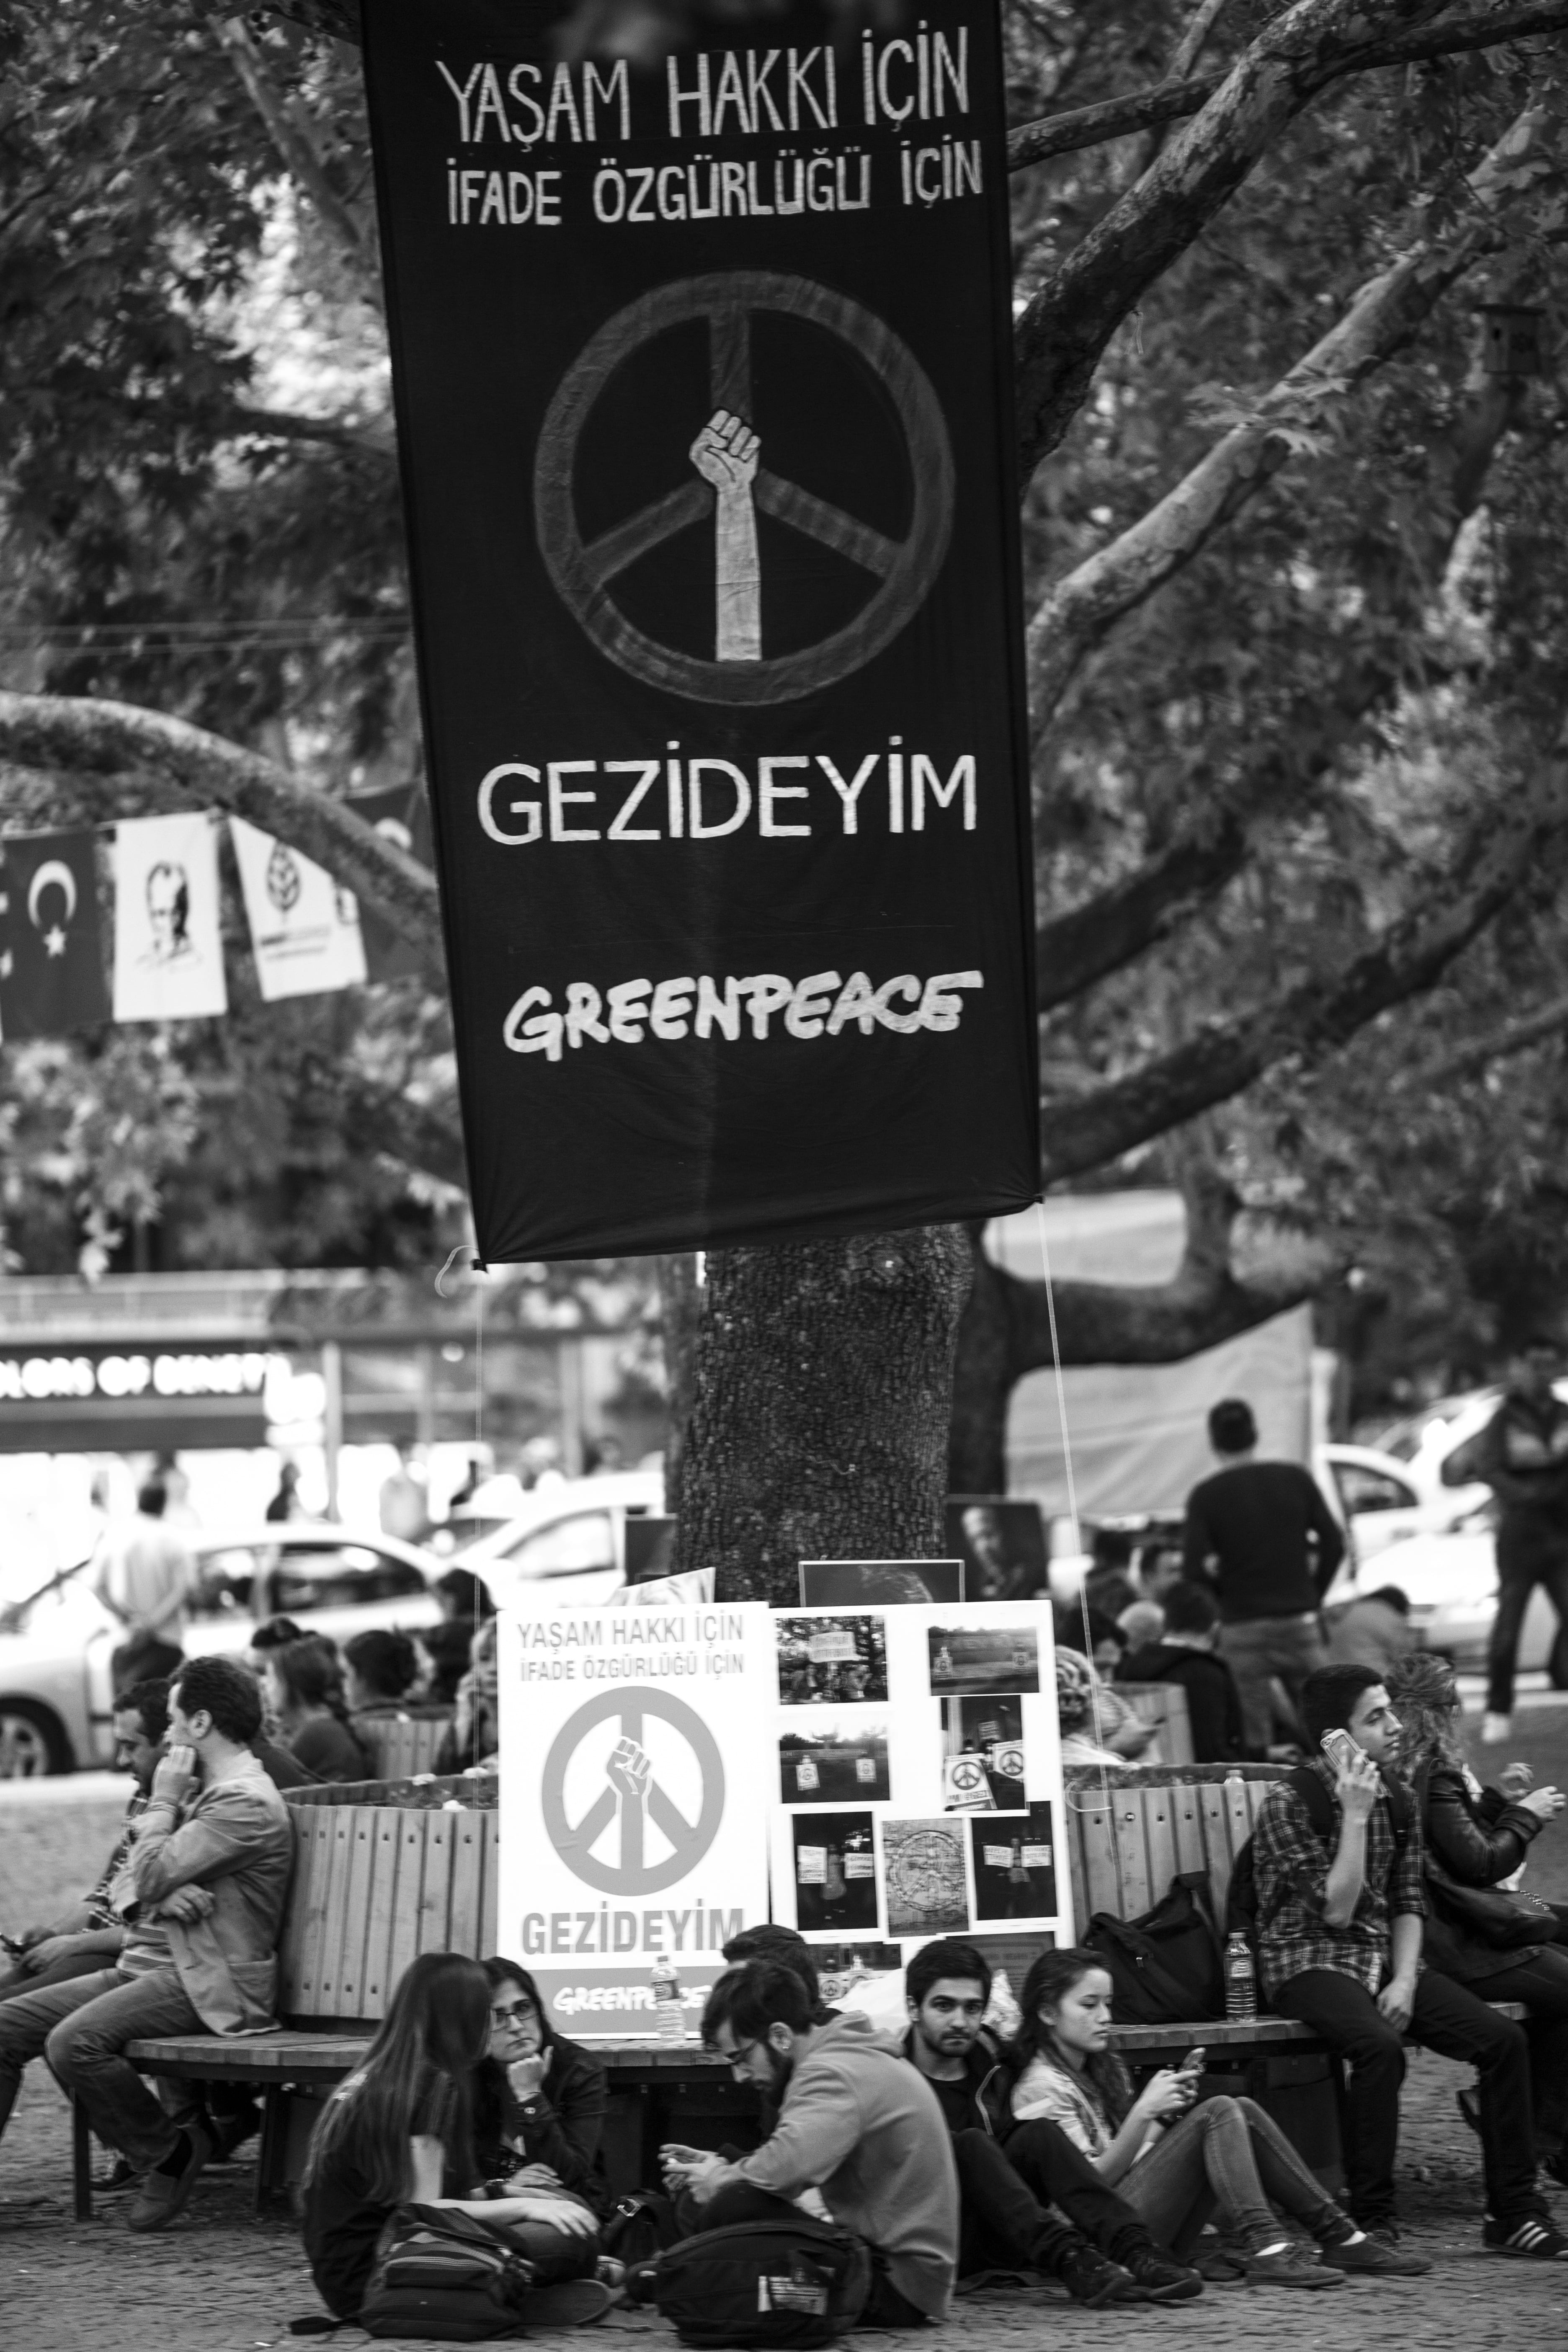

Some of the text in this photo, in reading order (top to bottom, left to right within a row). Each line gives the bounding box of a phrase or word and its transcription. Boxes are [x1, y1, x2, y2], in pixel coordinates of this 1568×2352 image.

[435, 20, 969, 152] YAŞAM HAKKI İÇİN
[447, 134, 983, 225] İFADE ÖZGÜRLÜĞÜ İÇİN
[477, 735, 976, 845] GEZİDEYİM
[503, 970, 983, 1062] GREENPEACE
[517, 1609, 743, 1654] YAŞAM HAKKI İÇİN
[520, 1649, 744, 1681] İFADE ÖZGÜRLÜĞÜ İÇİN
[522, 1898, 743, 1955] GEZİDEYİM
